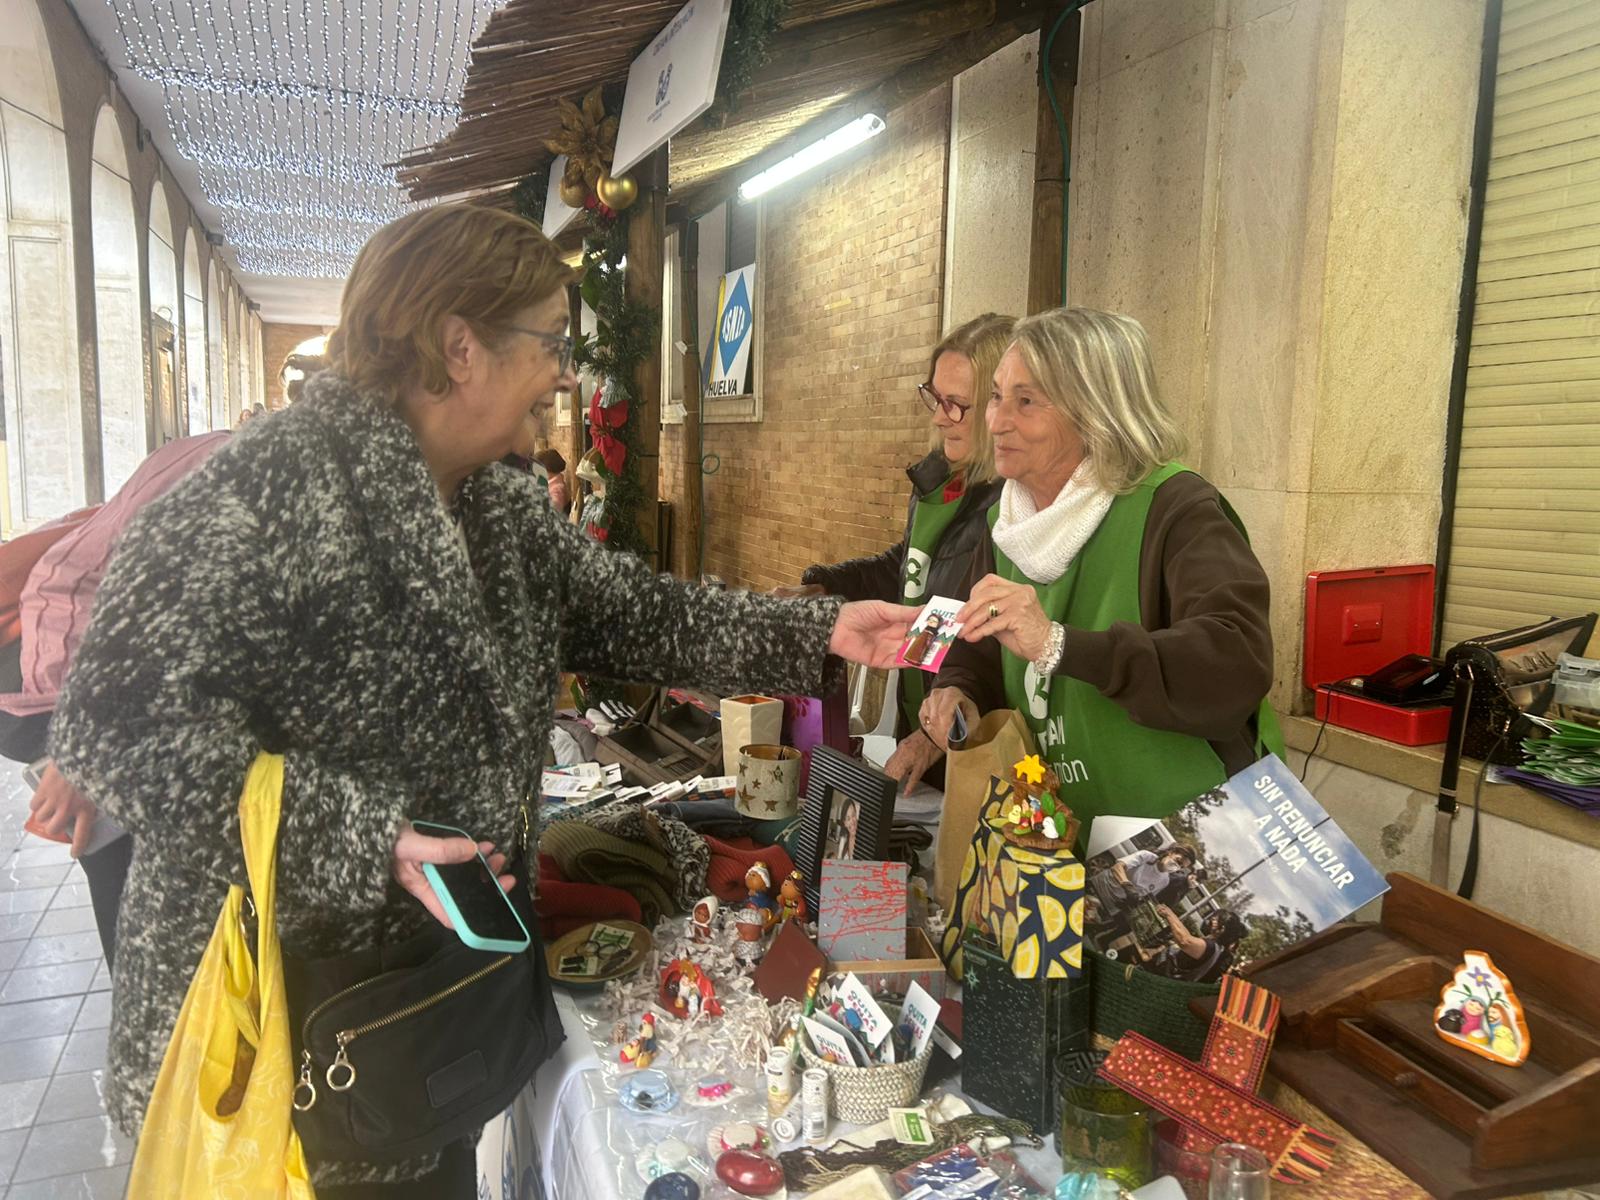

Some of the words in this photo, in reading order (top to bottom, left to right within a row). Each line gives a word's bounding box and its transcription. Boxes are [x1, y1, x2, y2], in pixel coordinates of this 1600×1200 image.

[708, 379, 738, 397] HUELVA
[1253, 813, 1273, 829] A
[1264, 826, 1308, 874] NADA
[1254, 775, 1284, 804] SIN
[1272, 799, 1355, 890] RENUNCIAR
